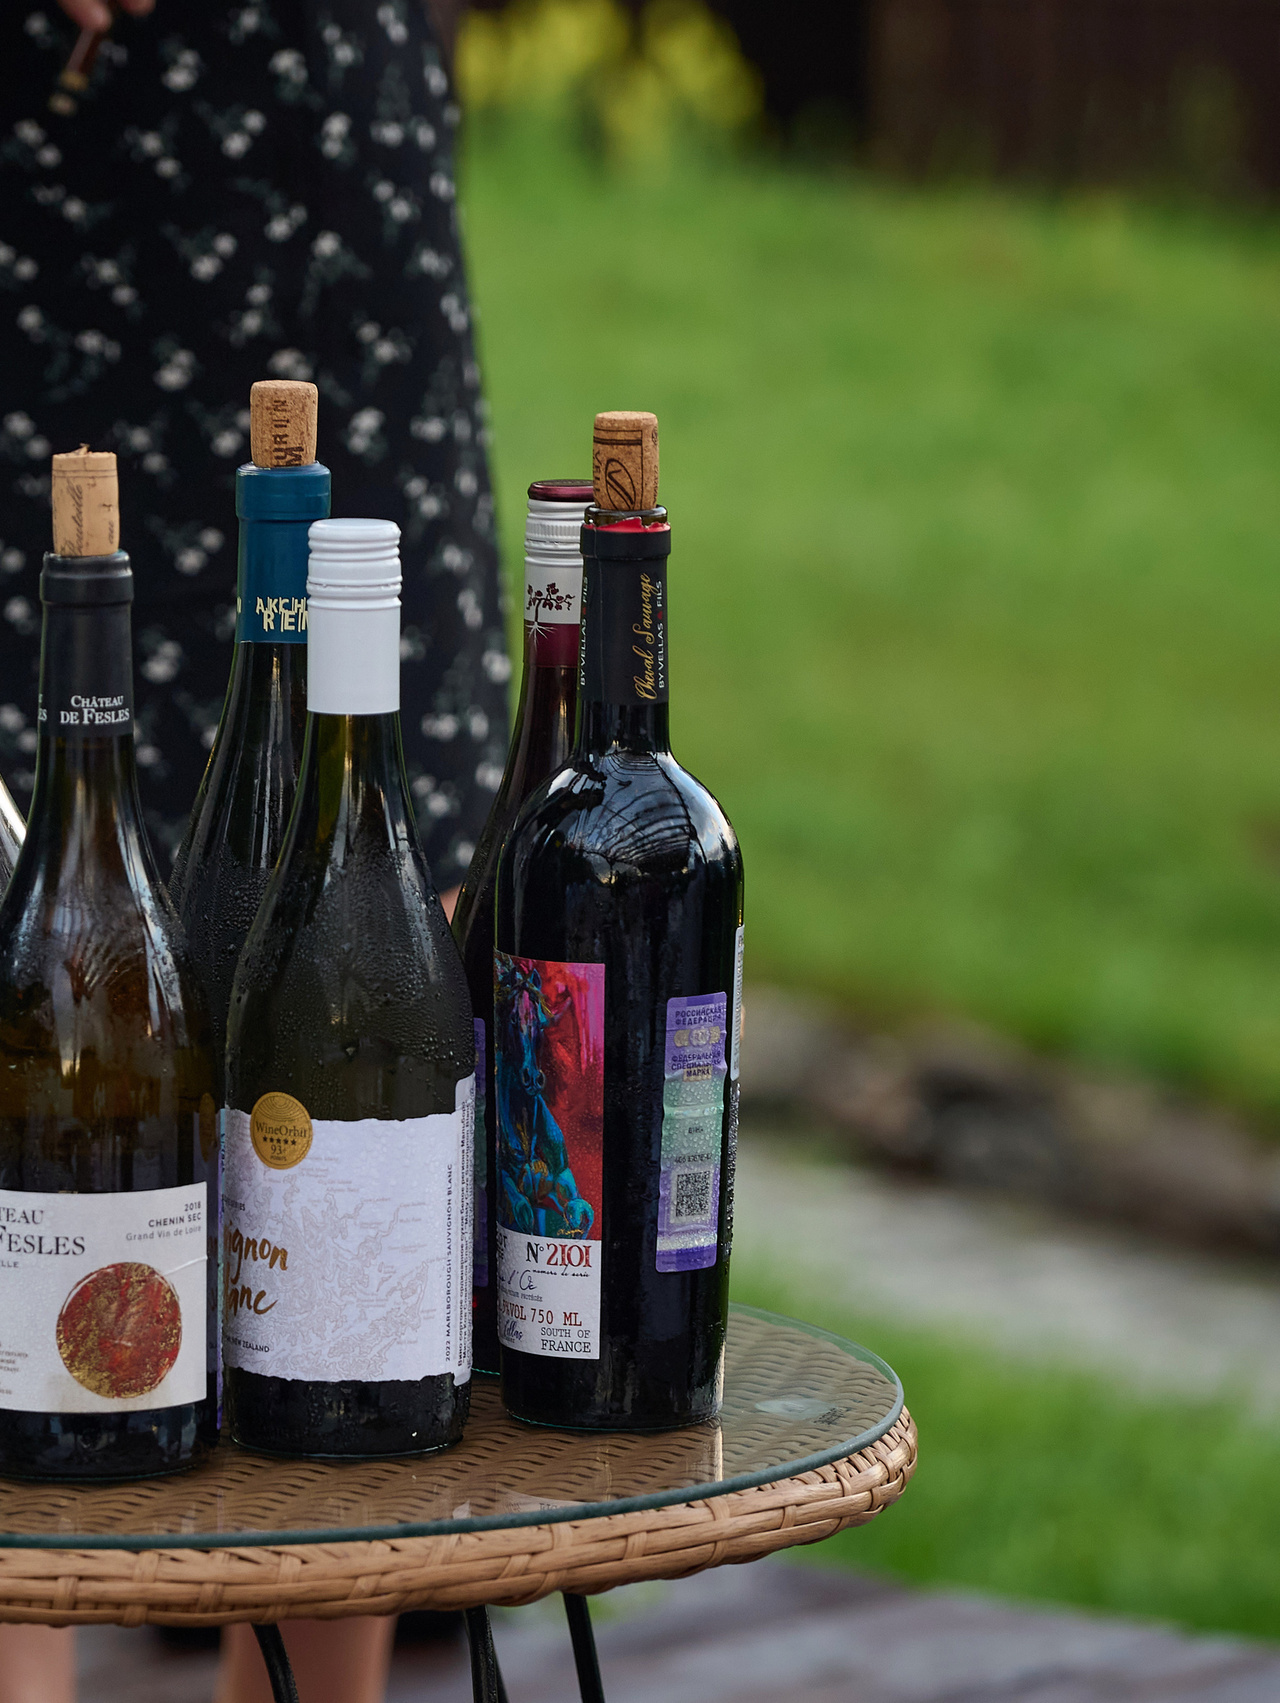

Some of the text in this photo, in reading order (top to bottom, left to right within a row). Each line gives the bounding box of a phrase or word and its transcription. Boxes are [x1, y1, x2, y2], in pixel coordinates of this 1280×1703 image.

[655, 580, 665, 689] BY VELLAS FILS
[632, 645, 658, 700] Cheval
[60, 707, 130, 725] DE FESLES
[255, 1120, 307, 1138] WineOrbit
[184, 1200, 202, 1212] 2018
[148, 1212, 202, 1228] CHENIN SEC
[125, 1231, 155, 1241] Grand
[157, 1229, 171, 1238] Vin
[173, 1227, 183, 1236] de
[530, 1307, 554, 1325] 750
[562, 1311, 582, 1327] ML
[541, 1326, 591, 1339] SOUTH OF
[242, 1340, 270, 1353] ZEALAND
[540, 1338, 592, 1354] FRANCE
